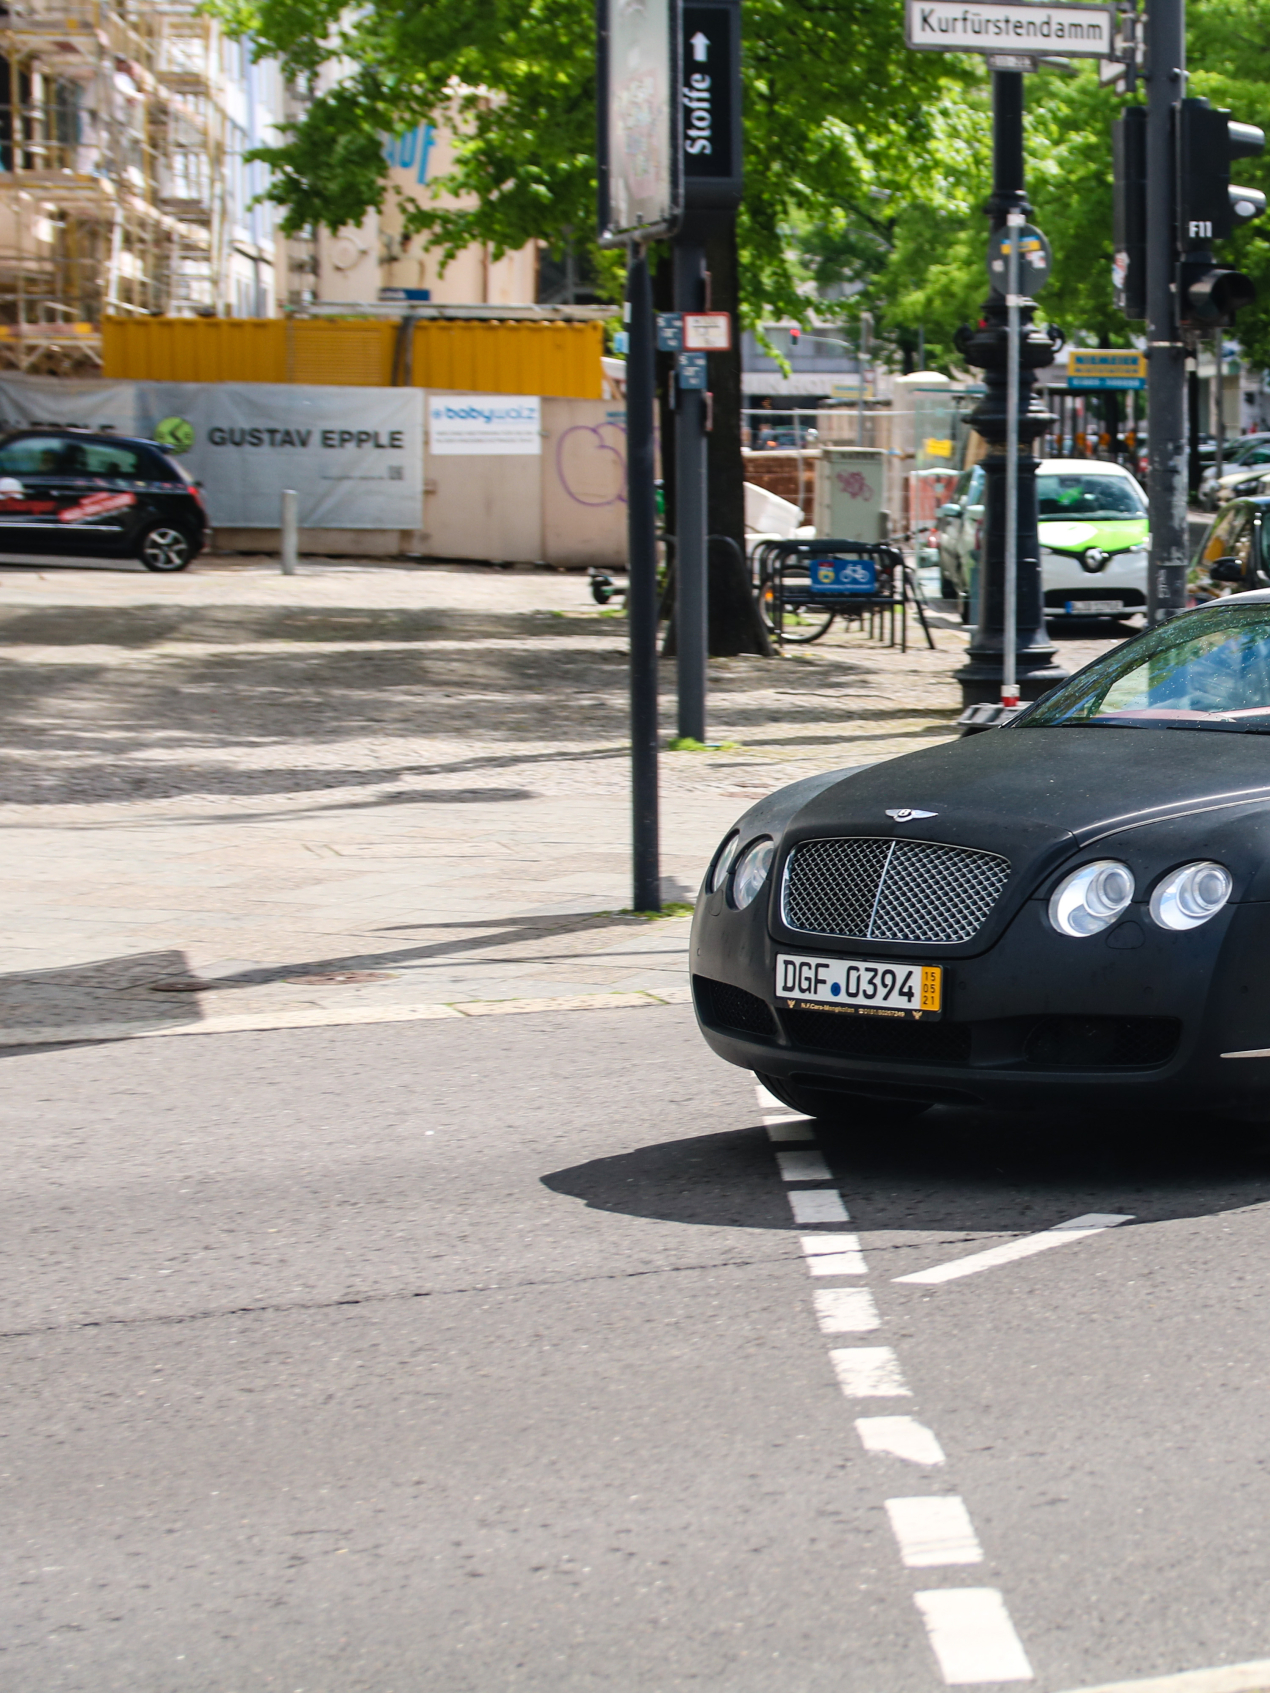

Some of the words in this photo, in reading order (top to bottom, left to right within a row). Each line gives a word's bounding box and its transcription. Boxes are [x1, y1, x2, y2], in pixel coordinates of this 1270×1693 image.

[920, 7, 1103, 40] Kurfürstendamm
[683, 73, 712, 155] Stoffe
[1189, 221, 1212, 237] F11
[208, 427, 313, 448] GUSTAV
[320, 430, 405, 449] EPPLE
[782, 959, 830, 995] DGF
[845, 965, 915, 1003] 0394
[924, 971, 936, 982] 15
[923, 983, 936, 994] 05
[923, 996, 935, 1006] 21
